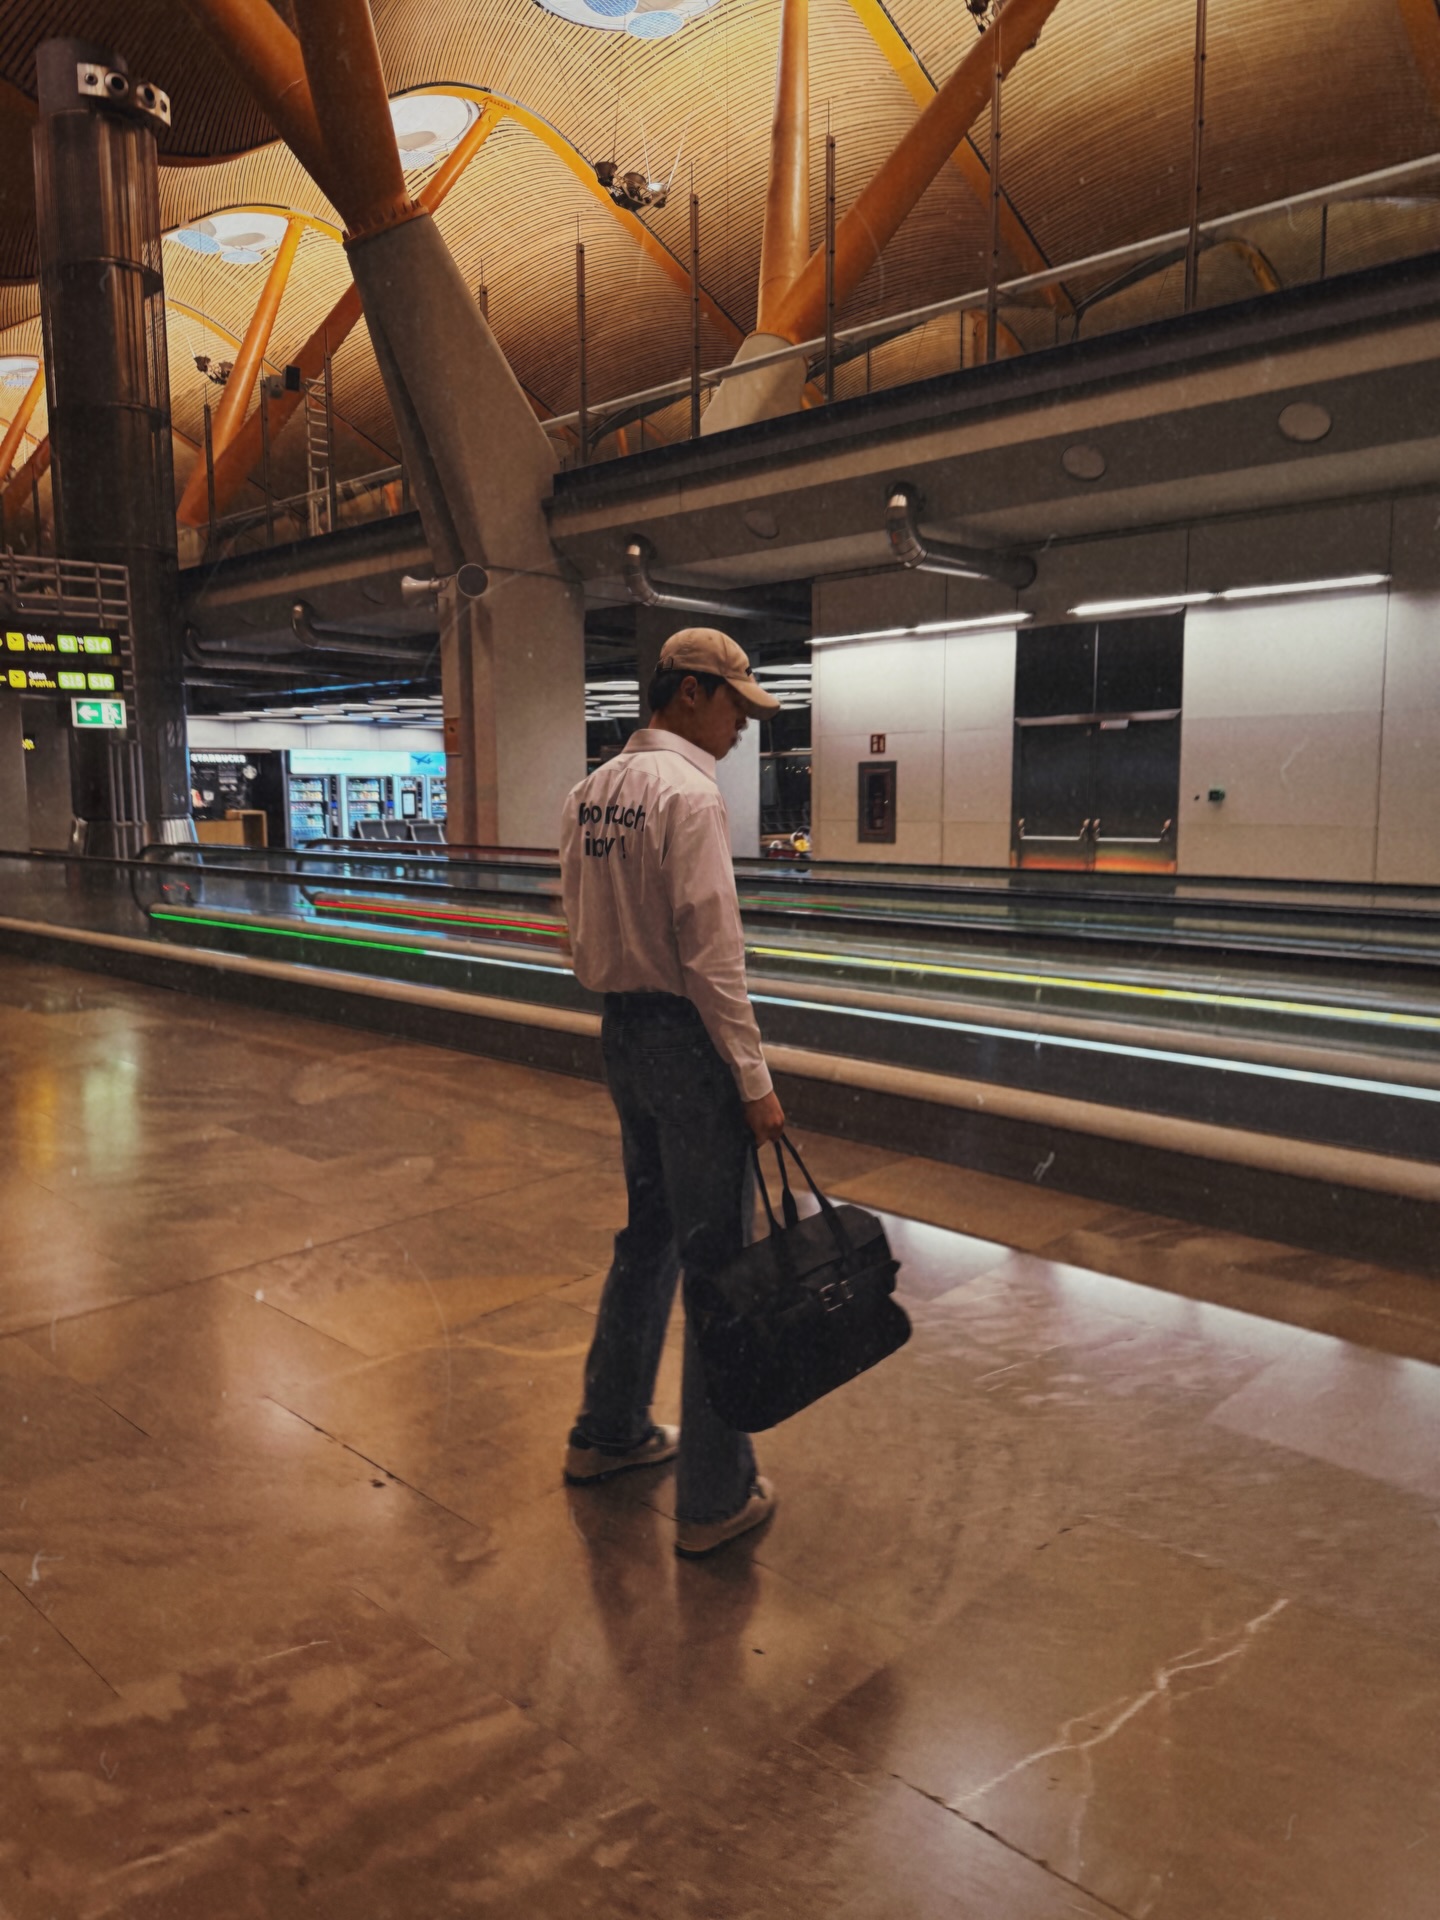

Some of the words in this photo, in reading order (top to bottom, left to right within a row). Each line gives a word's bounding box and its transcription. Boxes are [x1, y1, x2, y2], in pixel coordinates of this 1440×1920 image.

[61, 638, 75, 651] S1
[86, 638, 108, 651] S14
[89, 676, 112, 688] S16
[190, 753, 246, 763] STARBUCKS
